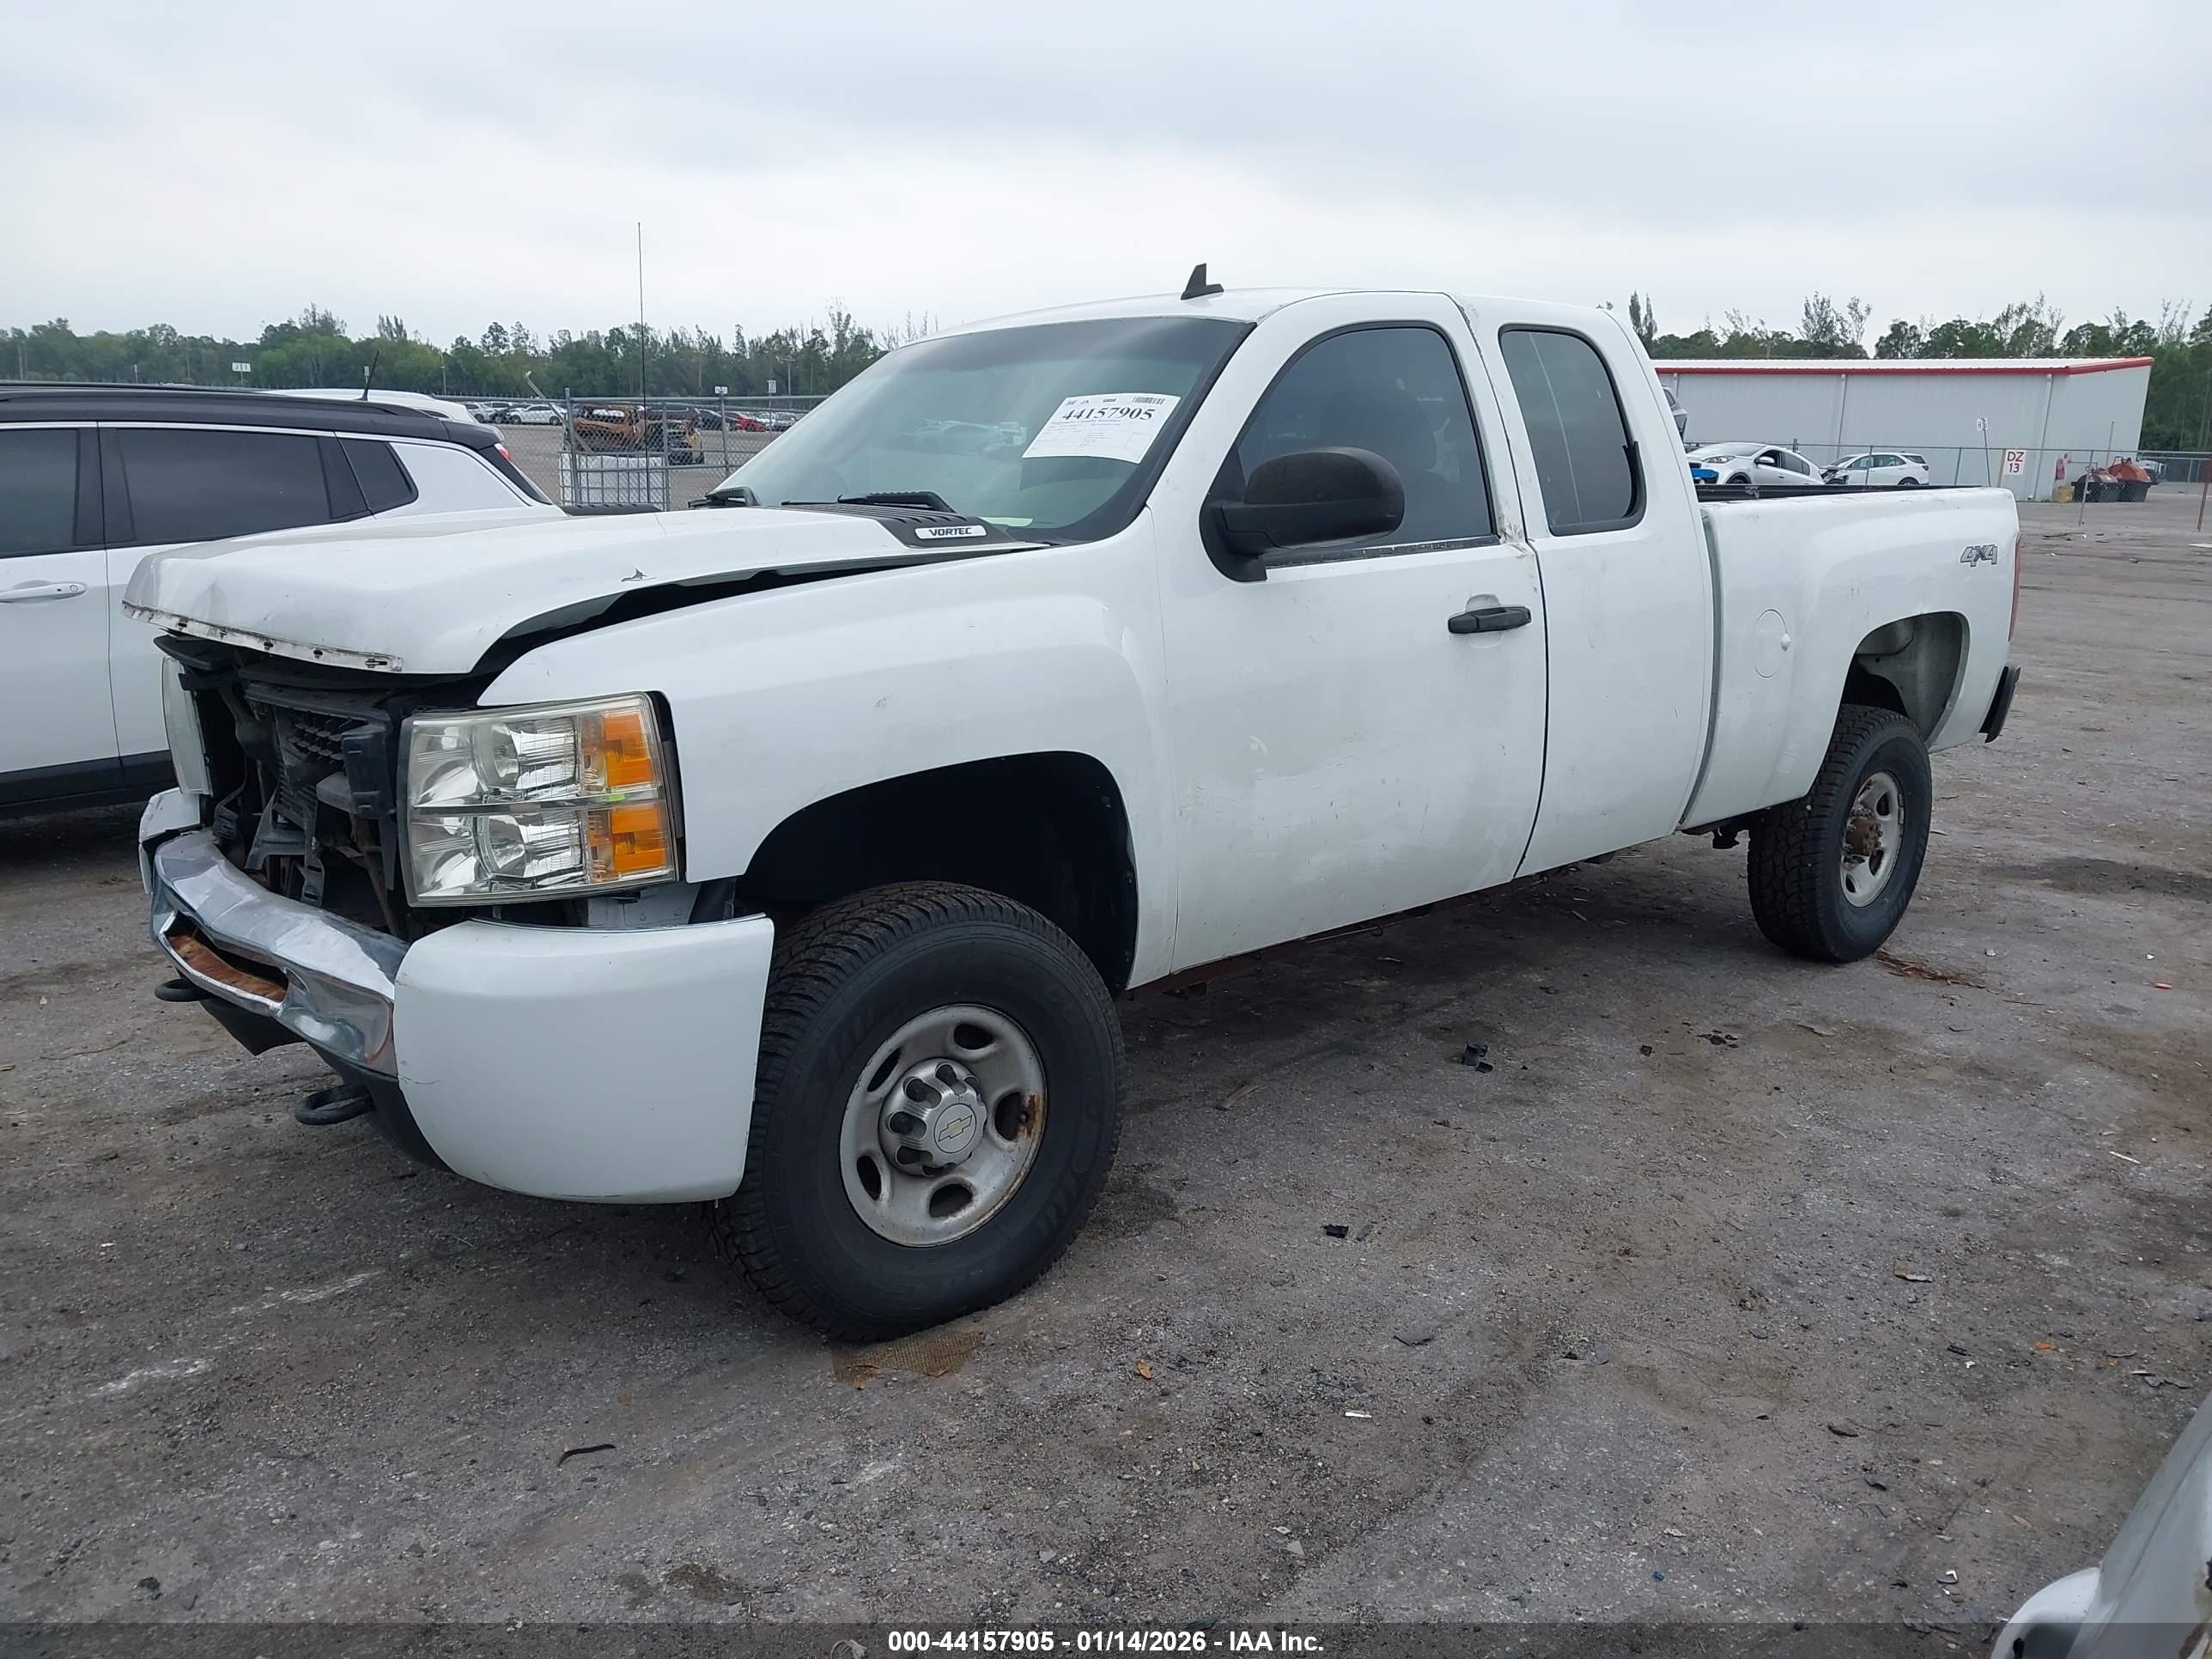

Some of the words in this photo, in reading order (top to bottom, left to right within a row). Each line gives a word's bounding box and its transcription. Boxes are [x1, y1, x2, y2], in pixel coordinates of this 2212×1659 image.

[1062, 406, 1156, 421] 44157905
[2007, 451, 2025, 462] DZ
[2009, 463, 2021, 473] 13
[928, 526, 972, 537] VORTEC
